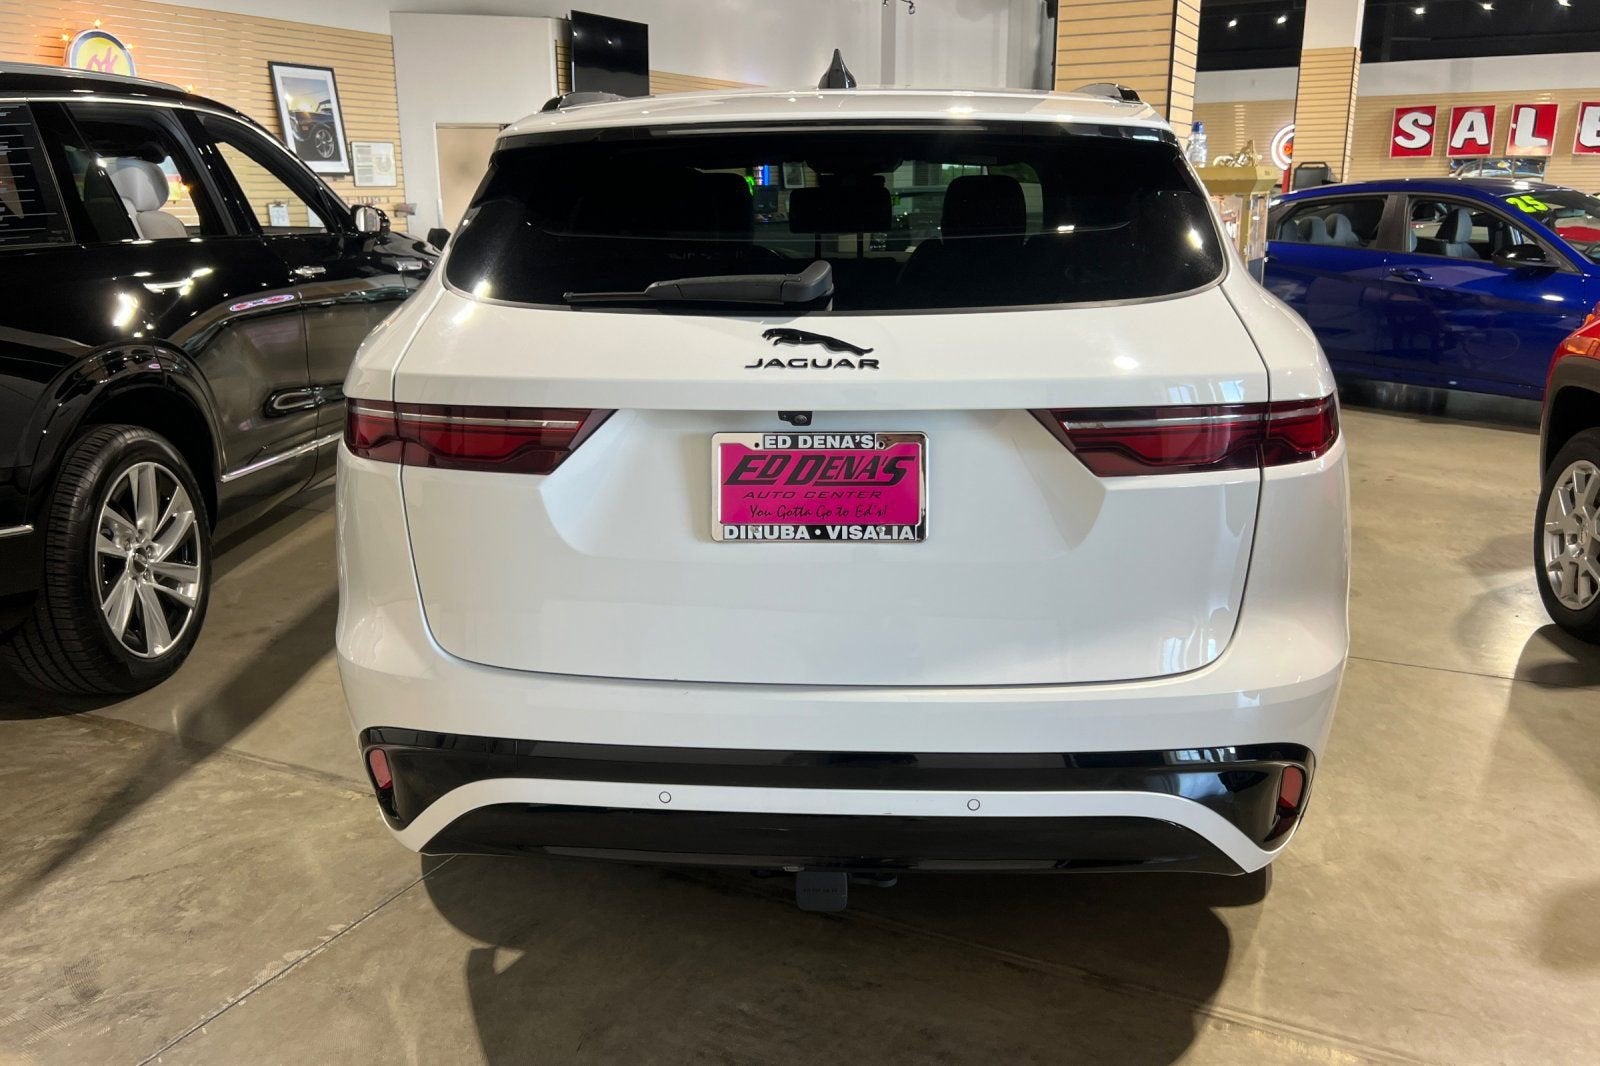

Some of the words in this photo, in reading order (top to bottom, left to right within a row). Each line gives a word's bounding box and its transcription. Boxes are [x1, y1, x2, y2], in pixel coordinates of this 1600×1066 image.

[1506, 195, 1549, 213] 25
[744, 358, 880, 370] JAGUAR
[764, 435, 792, 449] ED
[798, 435, 874, 449] DENA'S
[724, 454, 793, 486] ED
[743, 491, 796, 499] AUTO
[803, 491, 882, 499] CENTER
[750, 504, 771, 518] You
[777, 504, 812, 520] Gotta
[816, 505, 833, 520] Go
[836, 506, 849, 517] to
[723, 525, 810, 540] DINUBA
[825, 525, 915, 540] VISALIA
